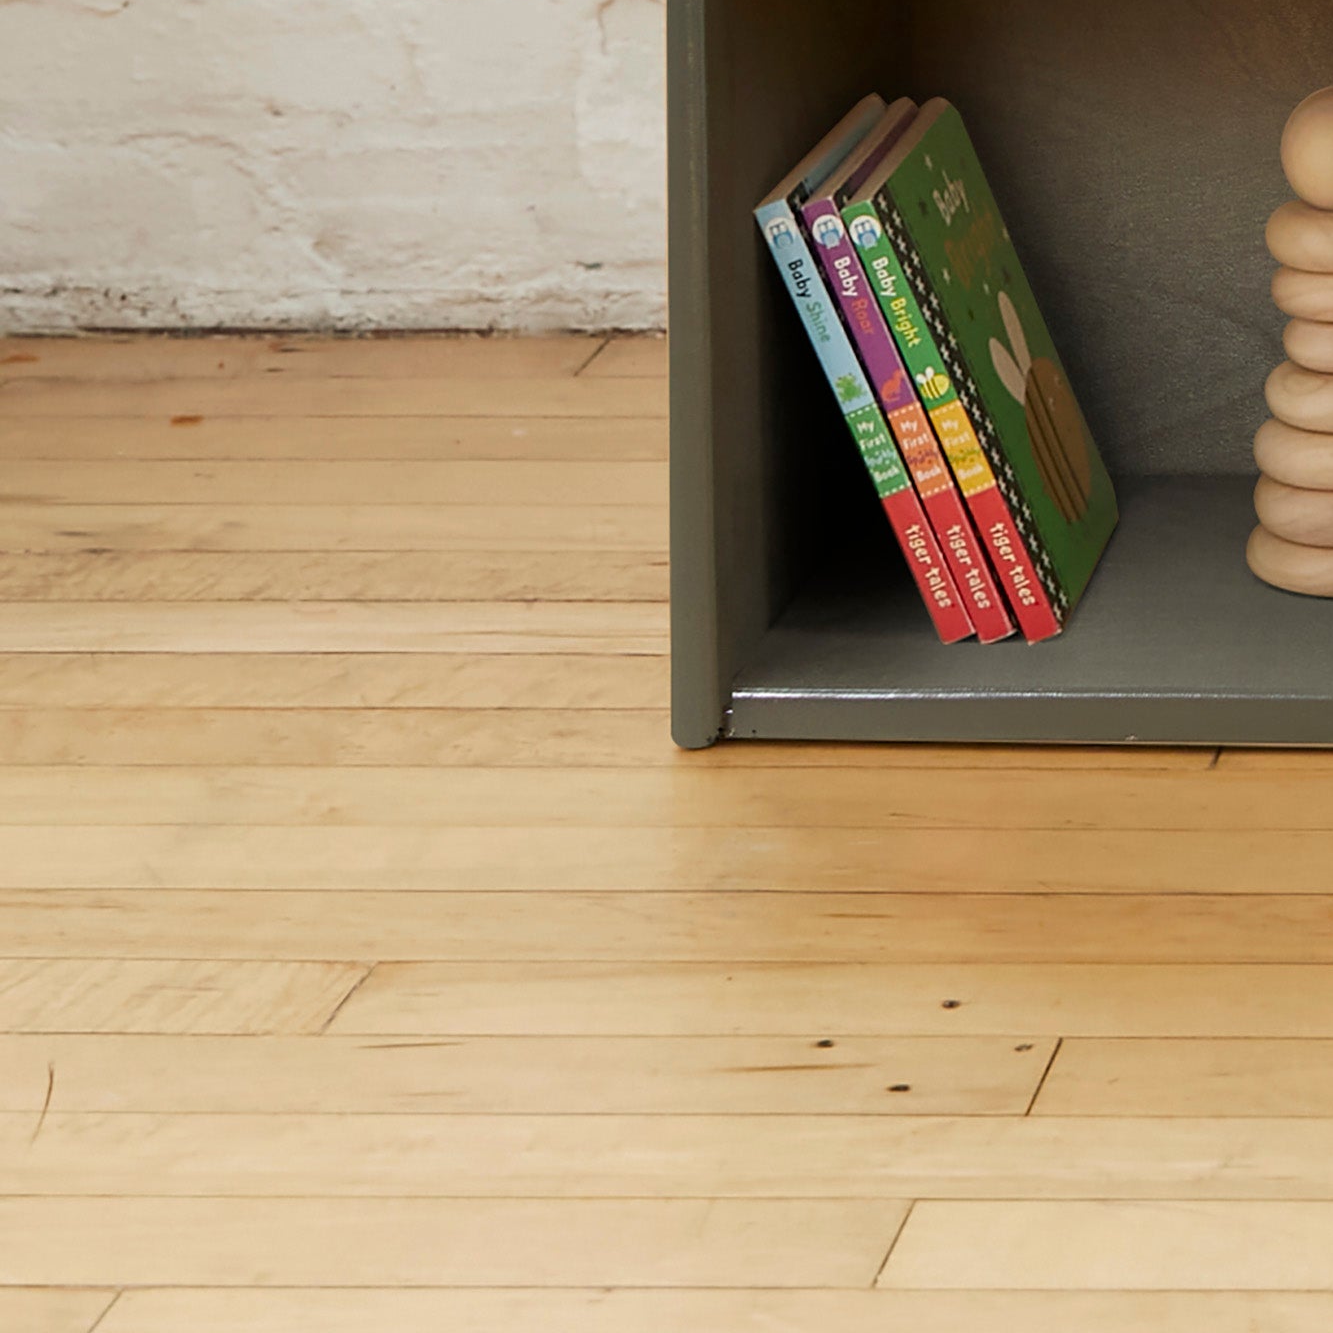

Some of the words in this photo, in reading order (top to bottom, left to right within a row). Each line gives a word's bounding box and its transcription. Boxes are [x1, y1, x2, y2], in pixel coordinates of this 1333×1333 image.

[788, 259, 812, 299] Baby
[806, 301, 830, 343] Shine
[834, 256, 858, 296] Baby
[852, 298, 873, 334] Roar
[872, 256, 896, 297] Baby
[891, 297, 921, 348] Bright
[857, 421, 874, 433] My
[900, 420, 917, 433] My
[942, 419, 958, 431] My
[905, 525, 932, 565] tiger
[925, 566, 952, 608] tales
[947, 525, 972, 565] tiger
[965, 567, 991, 609] tales
[990, 523, 1016, 562] tiger
[1010, 565, 1036, 606] tales
